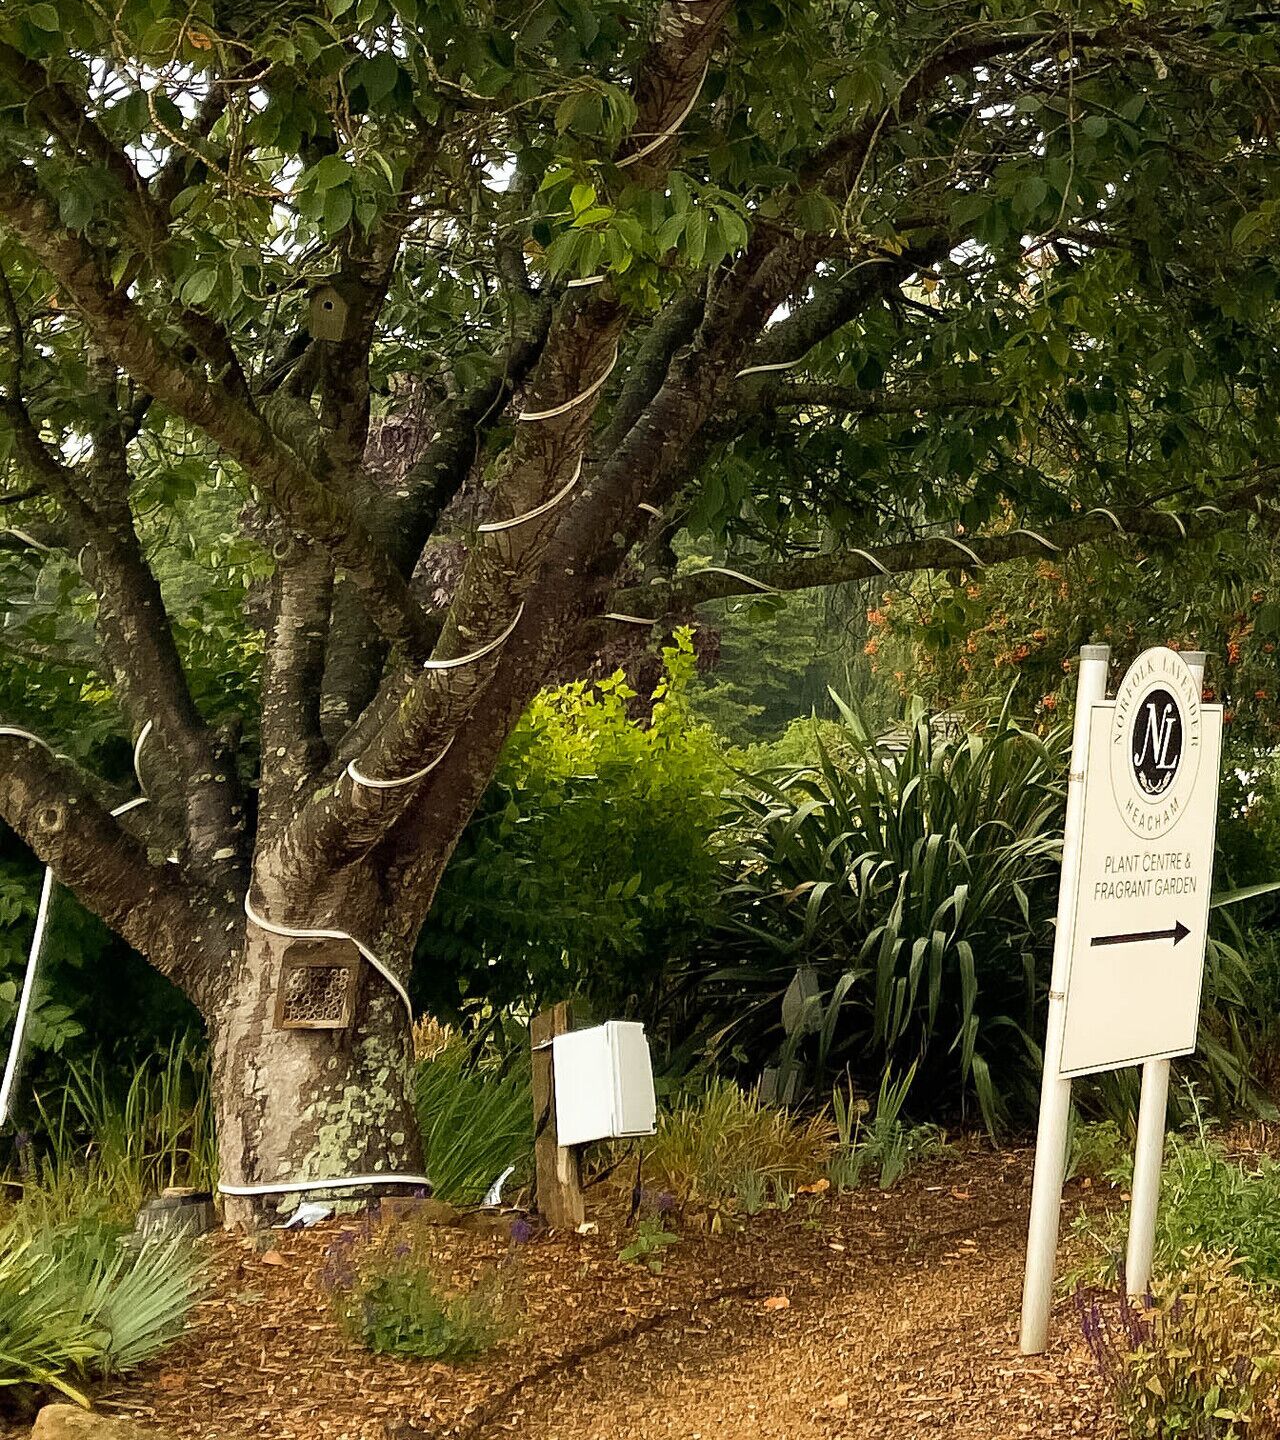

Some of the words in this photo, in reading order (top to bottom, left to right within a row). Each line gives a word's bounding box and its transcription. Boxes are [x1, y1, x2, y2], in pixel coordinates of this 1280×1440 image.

[1114, 660, 1155, 745] NORFOLK
[1163, 656, 1199, 747] LAVENDER
[1133, 703, 1179, 769] NL
[1125, 797, 1179, 831] HEACHAM
[1104, 854, 1140, 874] PLANT
[1142, 851, 1183, 872] CENTRE
[1184, 852, 1191, 870] &
[1093, 879, 1153, 900] FRAGRANT
[1154, 875, 1197, 896] GARDEN
